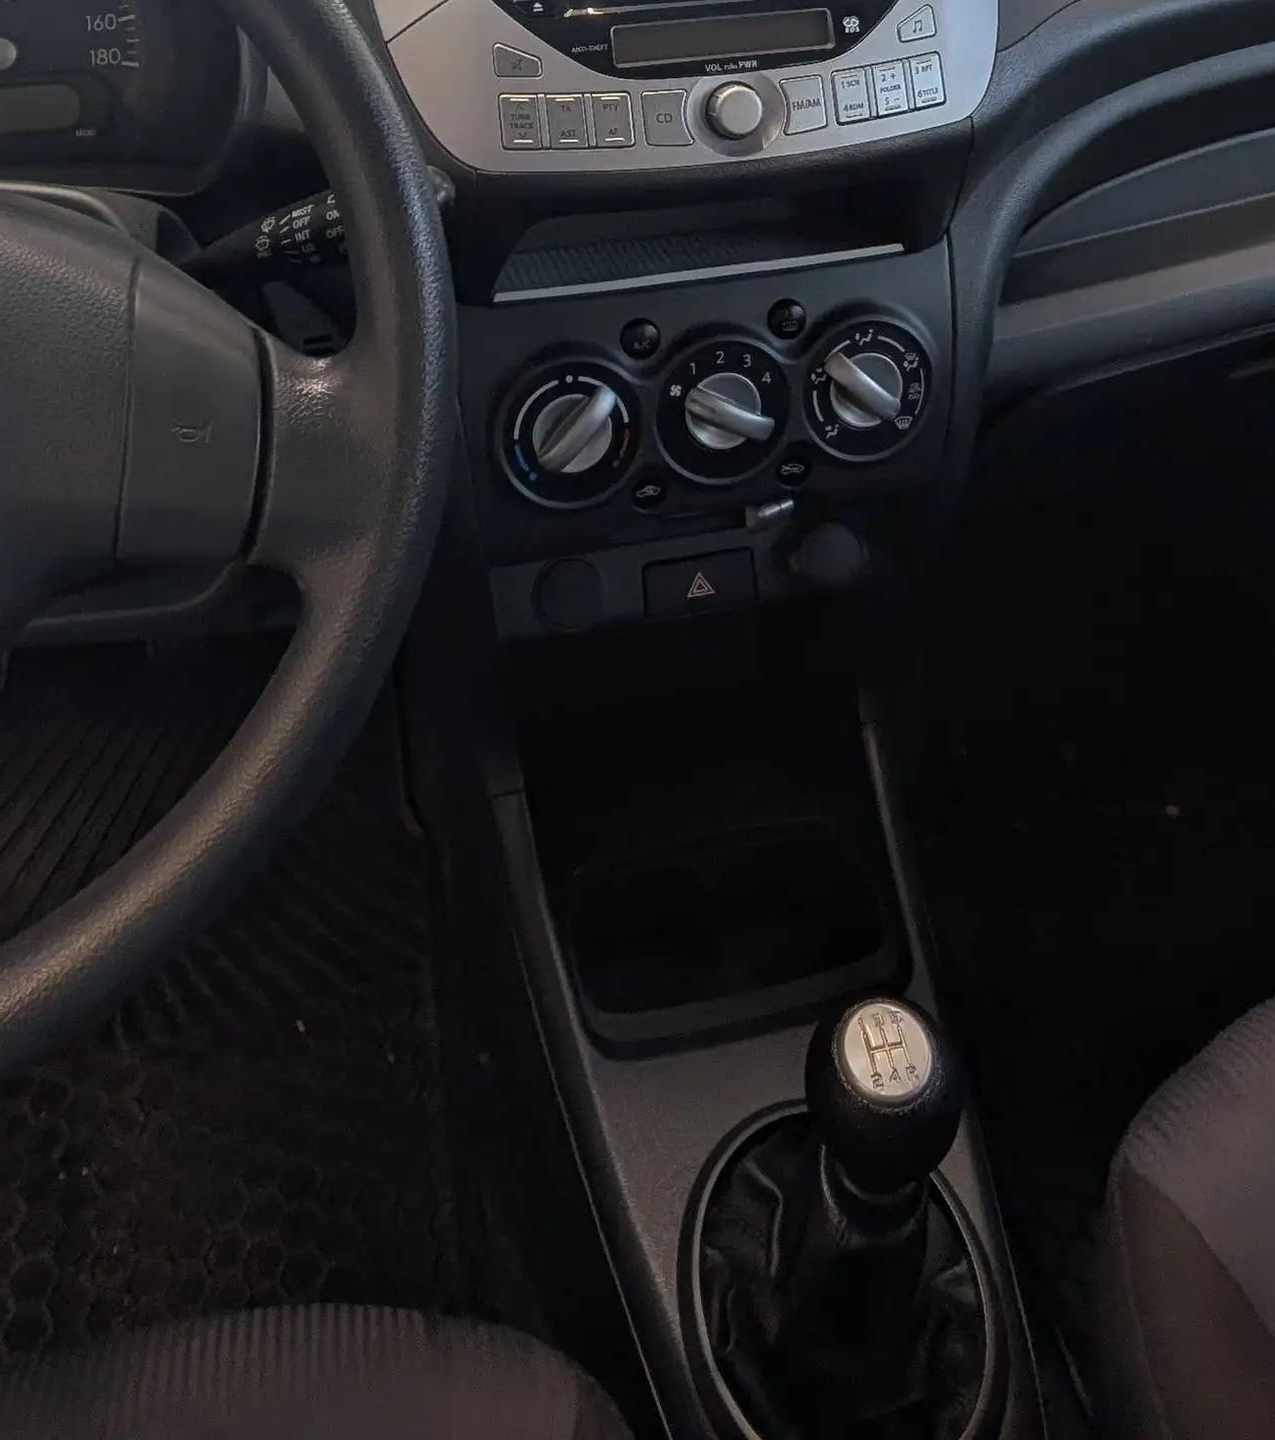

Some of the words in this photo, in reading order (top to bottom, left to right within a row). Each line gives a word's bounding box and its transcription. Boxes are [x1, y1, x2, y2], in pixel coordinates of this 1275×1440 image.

[85, 13, 116, 31] 160
[89, 48, 121, 65] 180
[705, 63, 723, 72] VOL
[738, 60, 758, 70] PWR
[792, 97, 822, 111] FM/AM
[656, 113, 673, 124] CD
[292, 216, 311, 229] OFF
[294, 229, 311, 243] INT
[715, 350, 726, 364] 2
[743, 353, 752, 368] 3
[689, 362, 697, 375] 1
[761, 371, 772, 384] 4
